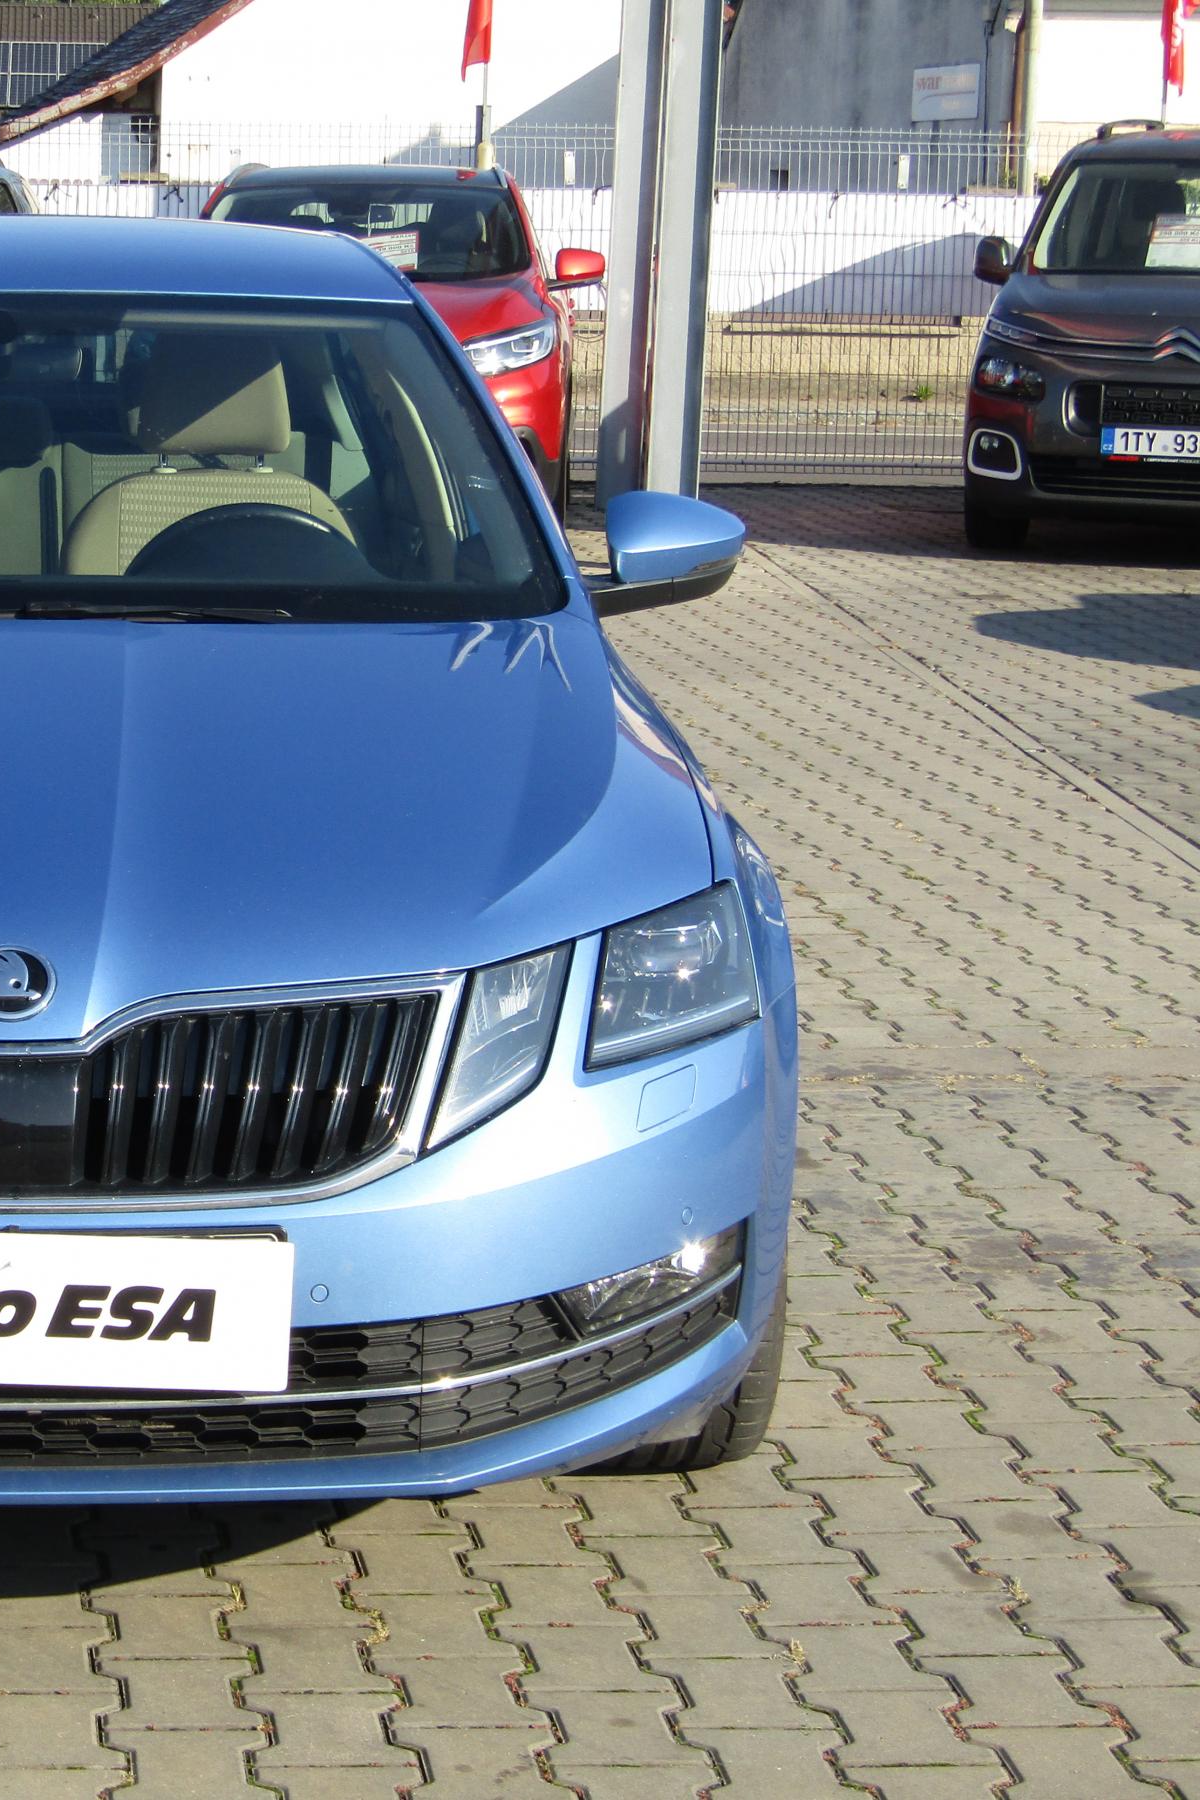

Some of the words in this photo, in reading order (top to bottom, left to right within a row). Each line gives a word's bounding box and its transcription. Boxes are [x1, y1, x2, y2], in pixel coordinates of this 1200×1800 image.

[1120, 431, 1157, 452] 1TY
[1174, 434, 1198, 453] 93
[44, 1284, 217, 1342] ESA
